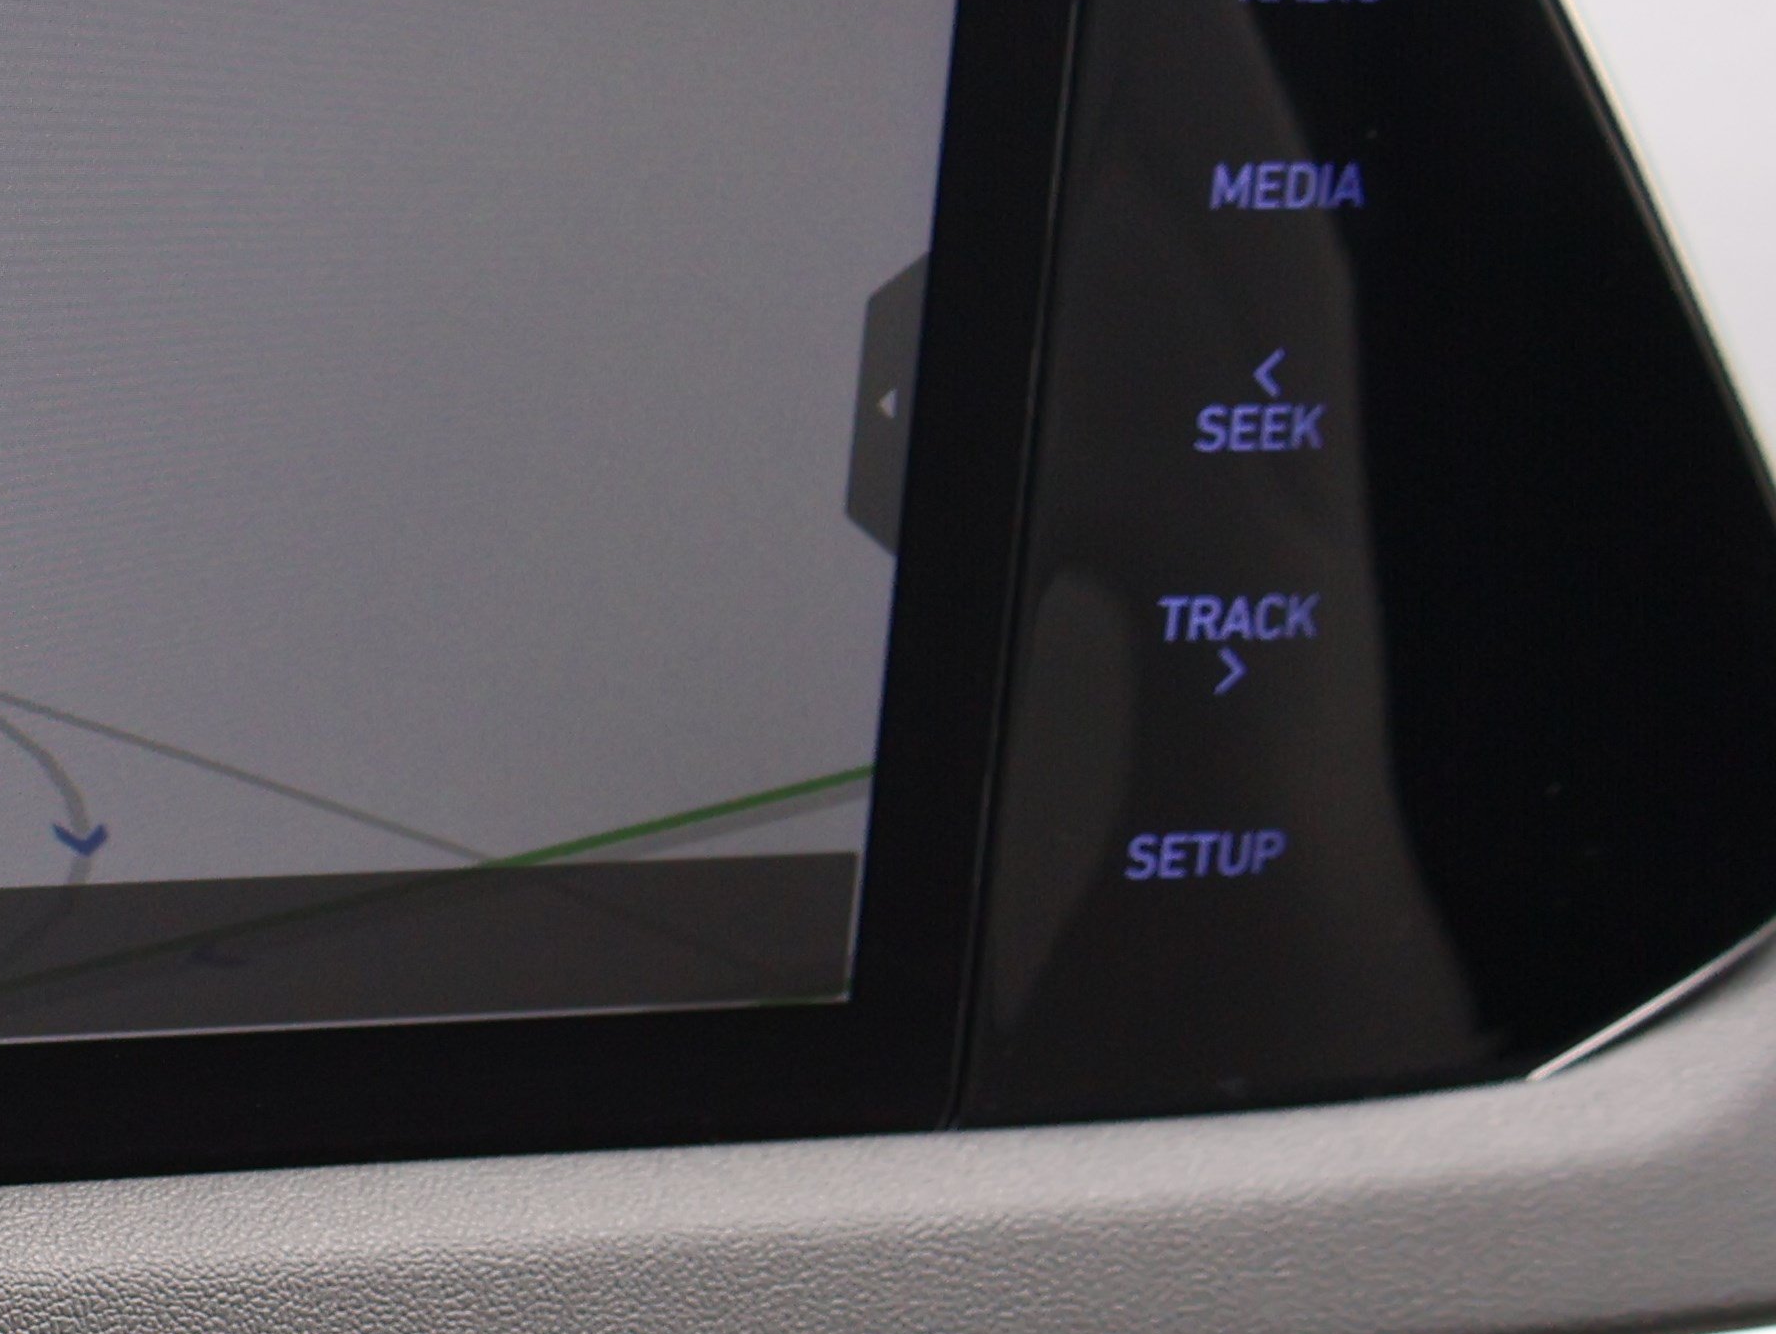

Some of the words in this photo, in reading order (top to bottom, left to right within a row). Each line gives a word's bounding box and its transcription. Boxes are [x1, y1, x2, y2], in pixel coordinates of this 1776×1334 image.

[1211, 161, 1364, 210] MEDIA
[1194, 403, 1325, 453] SEEK
[1157, 593, 1320, 641] TRACK
[1125, 829, 1286, 880] SETUP
